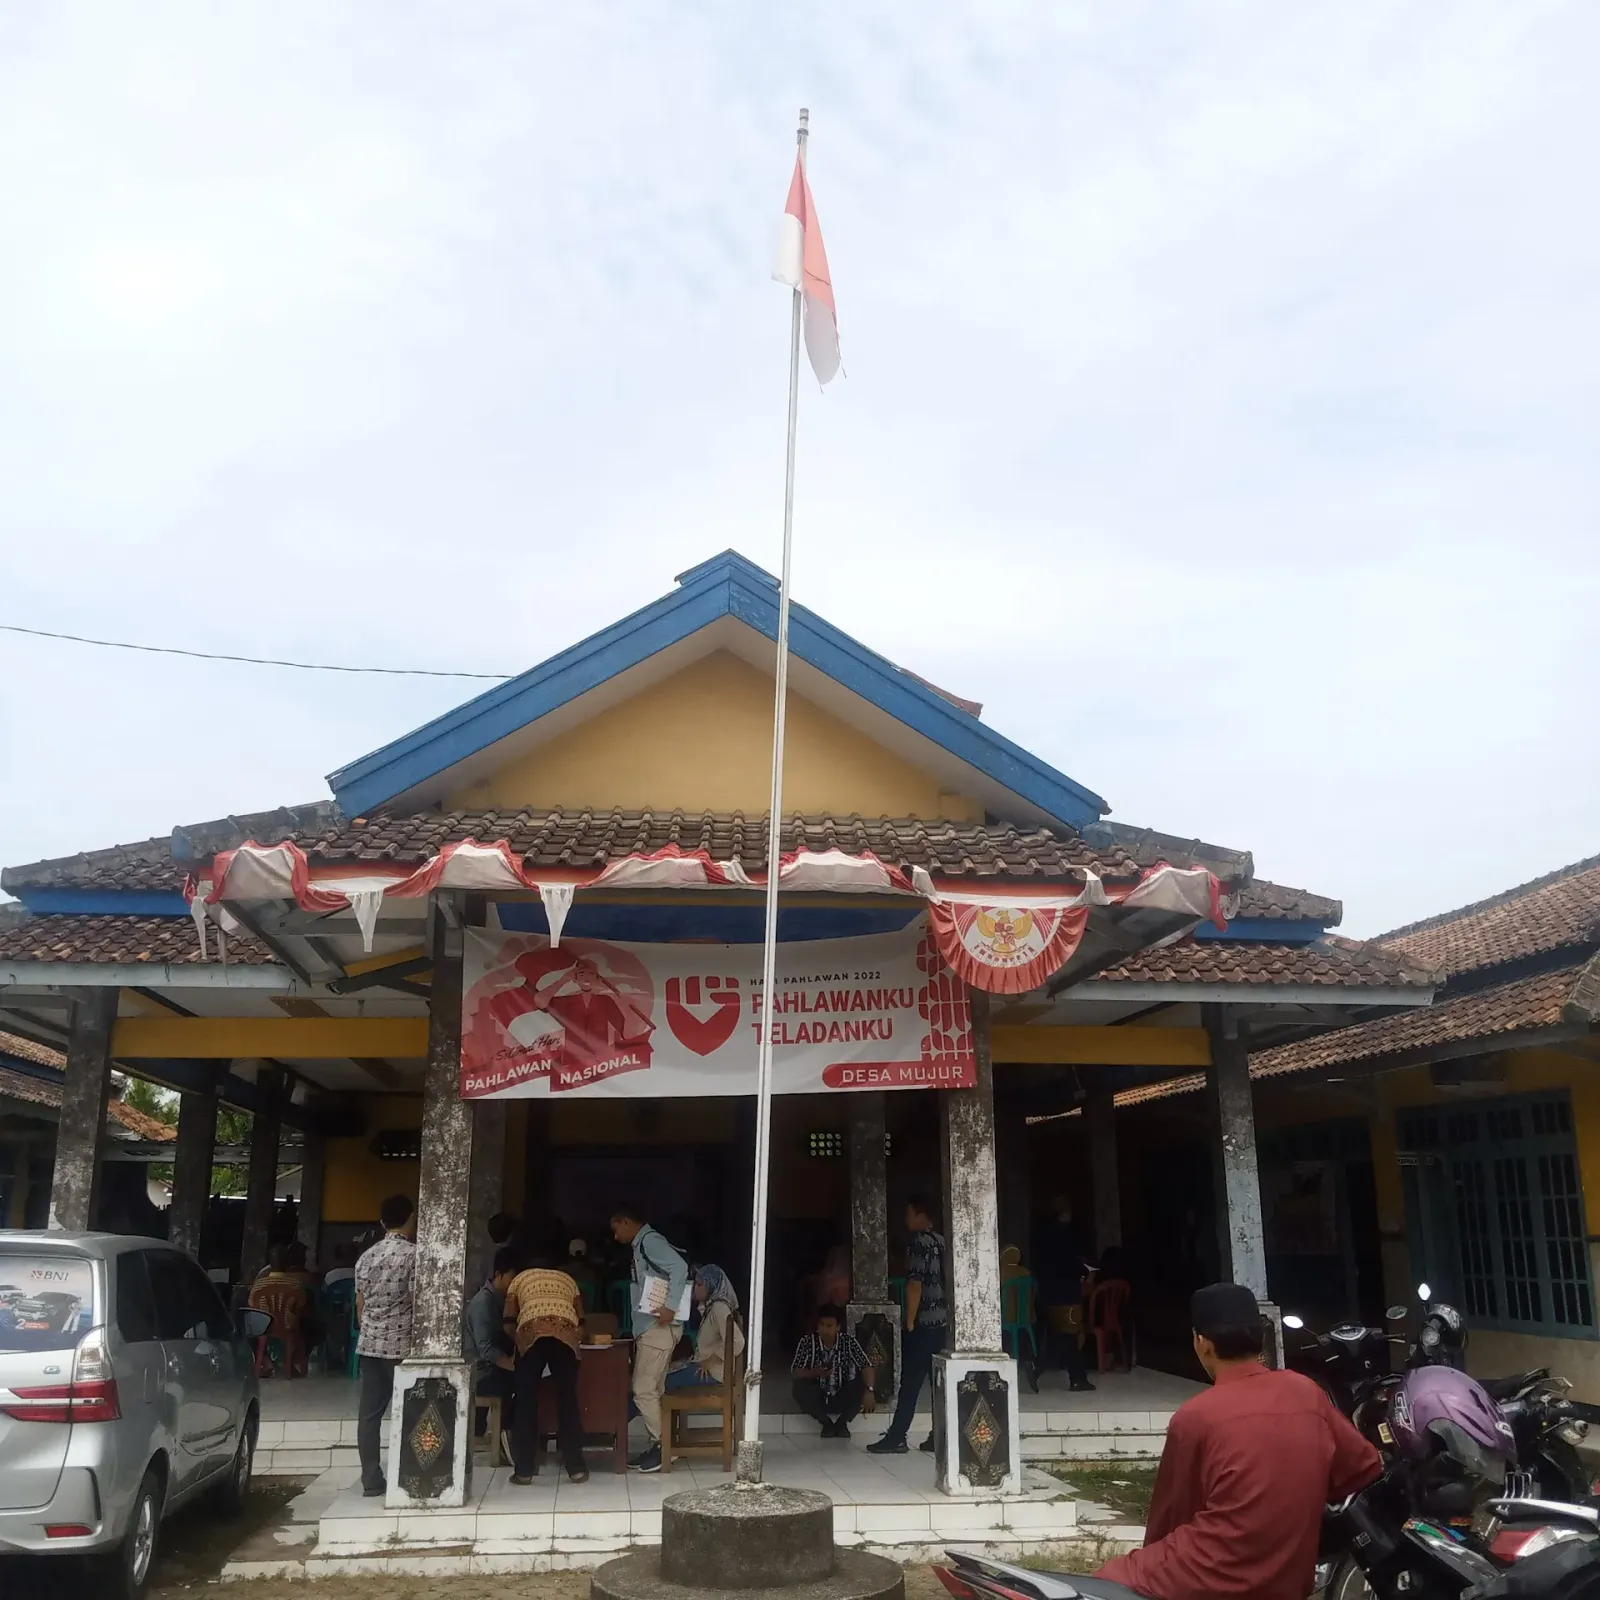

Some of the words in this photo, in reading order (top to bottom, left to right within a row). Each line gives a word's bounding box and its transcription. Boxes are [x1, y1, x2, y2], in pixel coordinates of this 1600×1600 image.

[750, 978, 778, 986] HAI
[784, 973, 849, 984] PAHLAWAN
[854, 971, 881, 980] 2022
[751, 987, 914, 1014] PAHLAWANKU
[751, 1018, 893, 1045] TELADANKU
[537, 1034, 562, 1048] Hari
[465, 1058, 551, 1091] PAHLAWAN
[559, 1053, 641, 1085] NASIONAL
[842, 1069, 892, 1083] DESA
[900, 1066, 963, 1080] MUJUR
[43, 1270, 69, 1281] BNI
